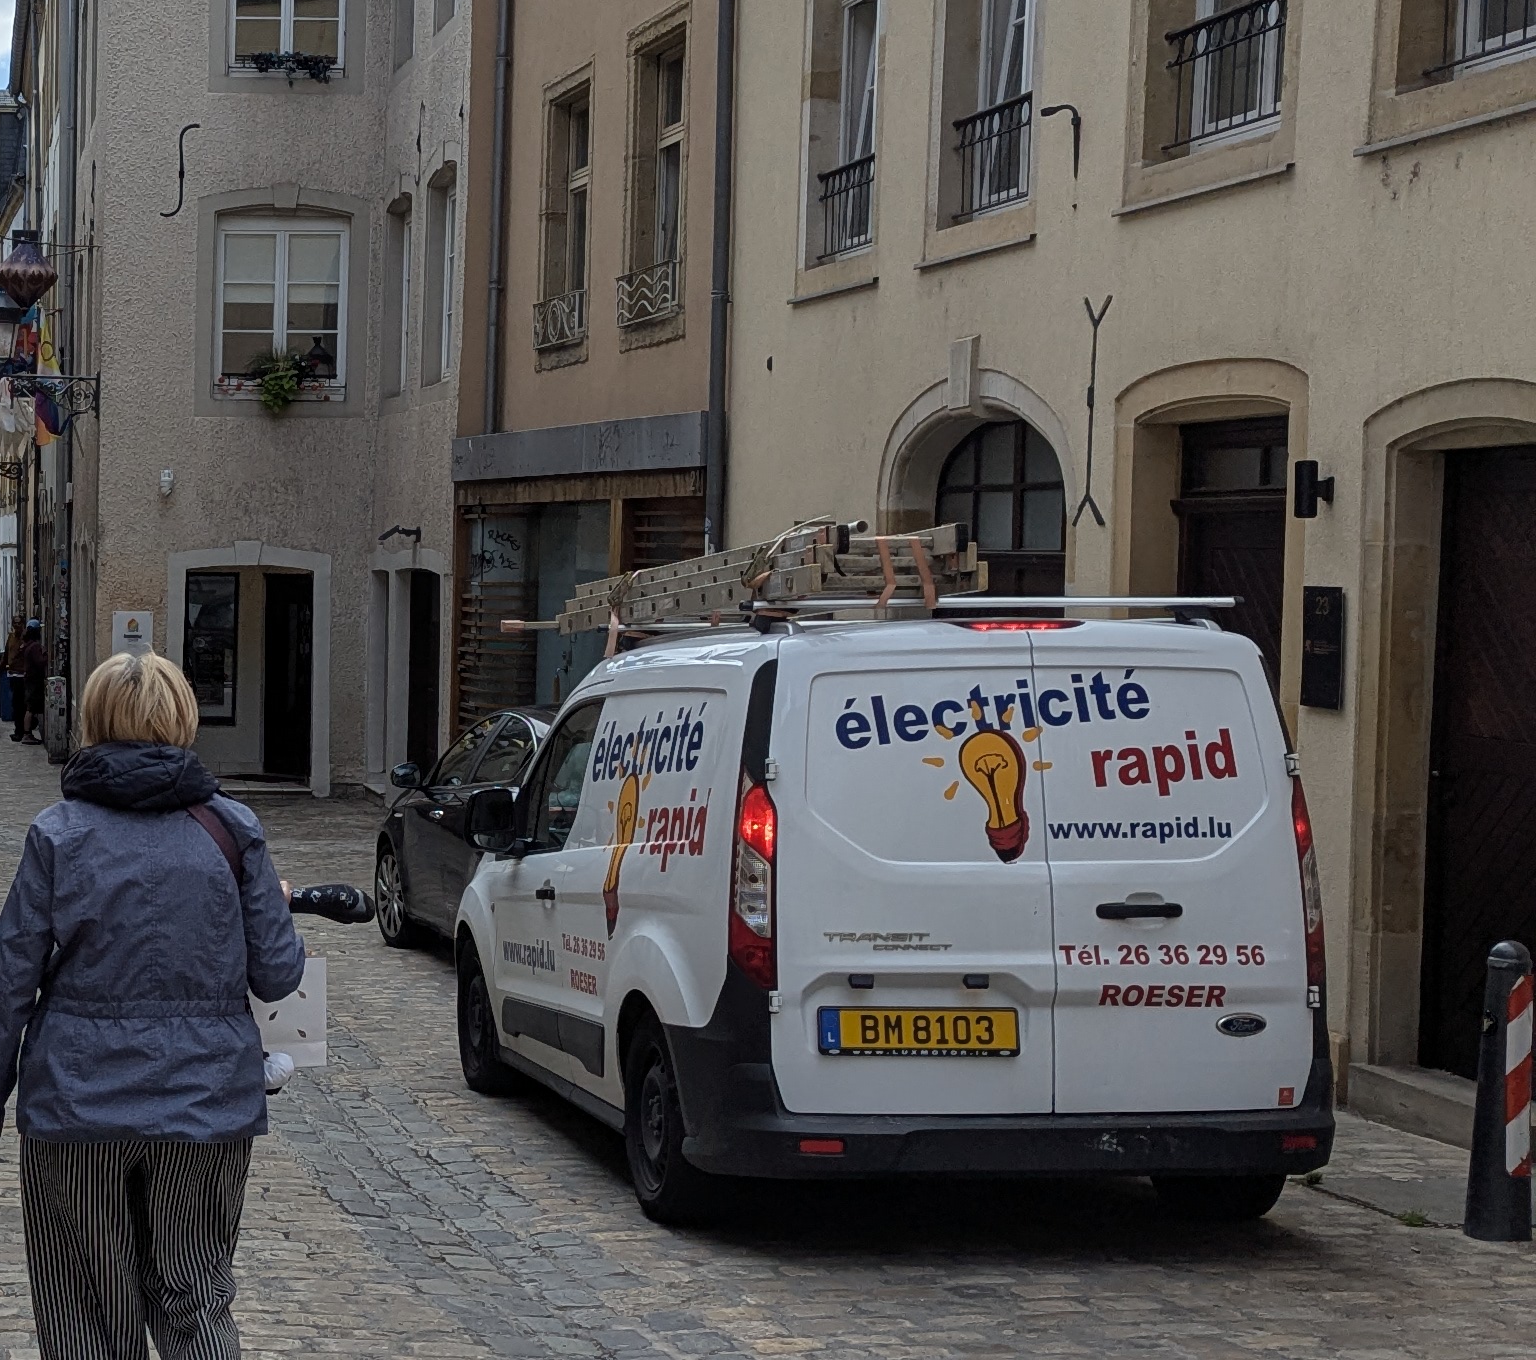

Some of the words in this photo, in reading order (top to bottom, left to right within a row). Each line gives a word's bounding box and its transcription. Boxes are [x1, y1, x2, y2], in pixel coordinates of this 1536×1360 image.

[1315, 596, 1329, 615] 23
[835, 668, 1151, 750] électricité
[592, 702, 708, 783] électricité
[1090, 728, 1238, 797] rapid
[639, 788, 712, 872] rapid
[1048, 817, 1232, 844] www.rapid.lu
[573, 936, 581, 955] 26
[581, 938, 588, 957] 36
[589, 940, 597, 959] 29
[597, 942, 606, 961] 56
[823, 932, 930, 943] TRANSIT
[503, 939, 556, 976] www.rapid.lu
[1058, 945, 1110, 966] Tél.
[1117, 945, 1151, 966] 26
[1157, 945, 1190, 966] 36
[1197, 945, 1228, 966] 29
[1236, 945, 1266, 966] 56
[570, 969, 598, 996] ROESER
[1098, 985, 1227, 1008] ROESER
[827, 1032, 836, 1043] L
[860, 1015, 904, 1045] BM
[912, 1015, 995, 1045] 8103
